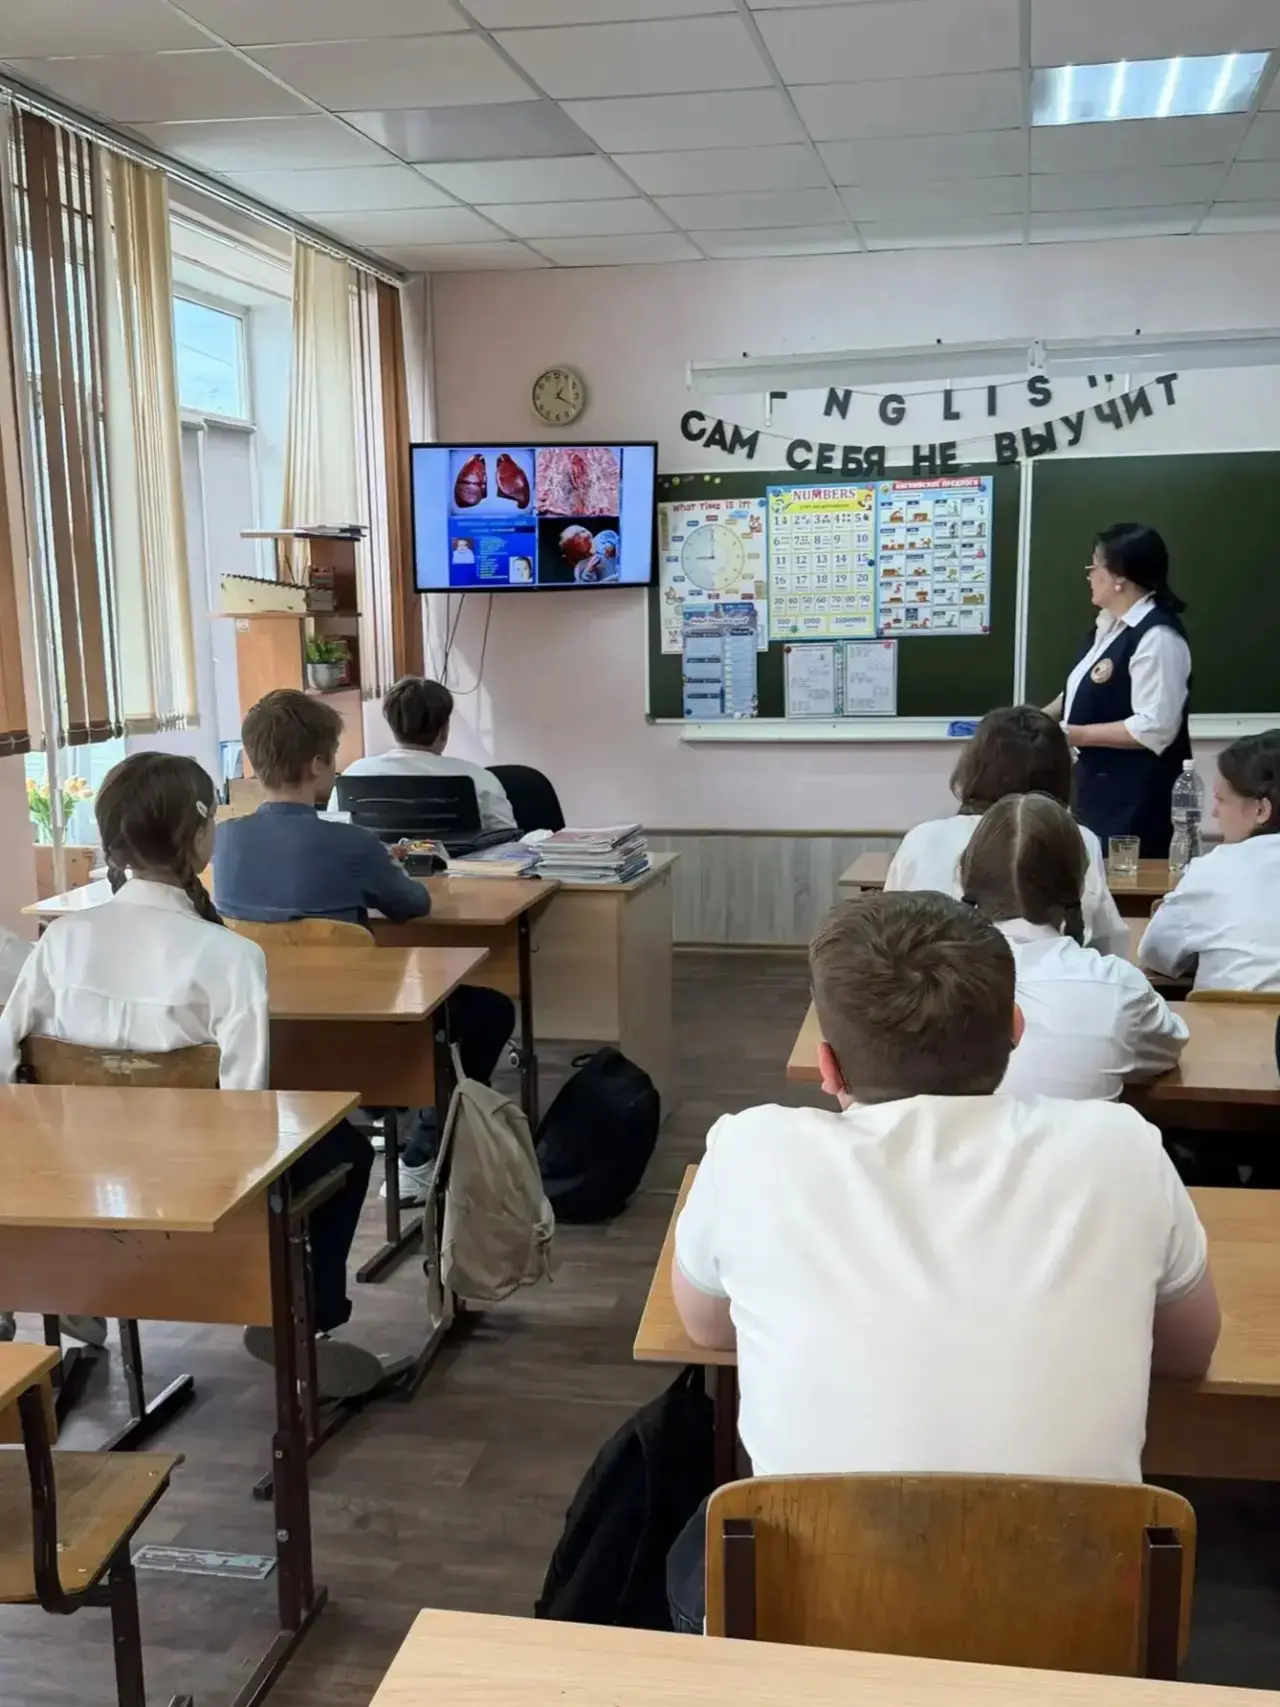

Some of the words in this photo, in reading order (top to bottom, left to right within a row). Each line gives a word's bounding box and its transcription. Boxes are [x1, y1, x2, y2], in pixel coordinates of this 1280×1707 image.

[680, 410, 760, 460] САМ
[786, 438, 886, 478] СЕБЯ
[912, 441, 957, 476] НЕ
[995, 372, 1178, 466] ВЫУЧИТ
[792, 488, 857, 501] NUMBERS
[775, 556, 786, 564] 11
[796, 556, 807, 564] 12
[817, 555, 827, 563] 13
[836, 555, 846, 563] 14
[857, 553, 868, 562] 15
[775, 576, 786, 585] 16
[796, 576, 807, 584] 17
[816, 575, 828, 583] 18
[836, 574, 847, 583] 19
[857, 574, 868, 582] 20
